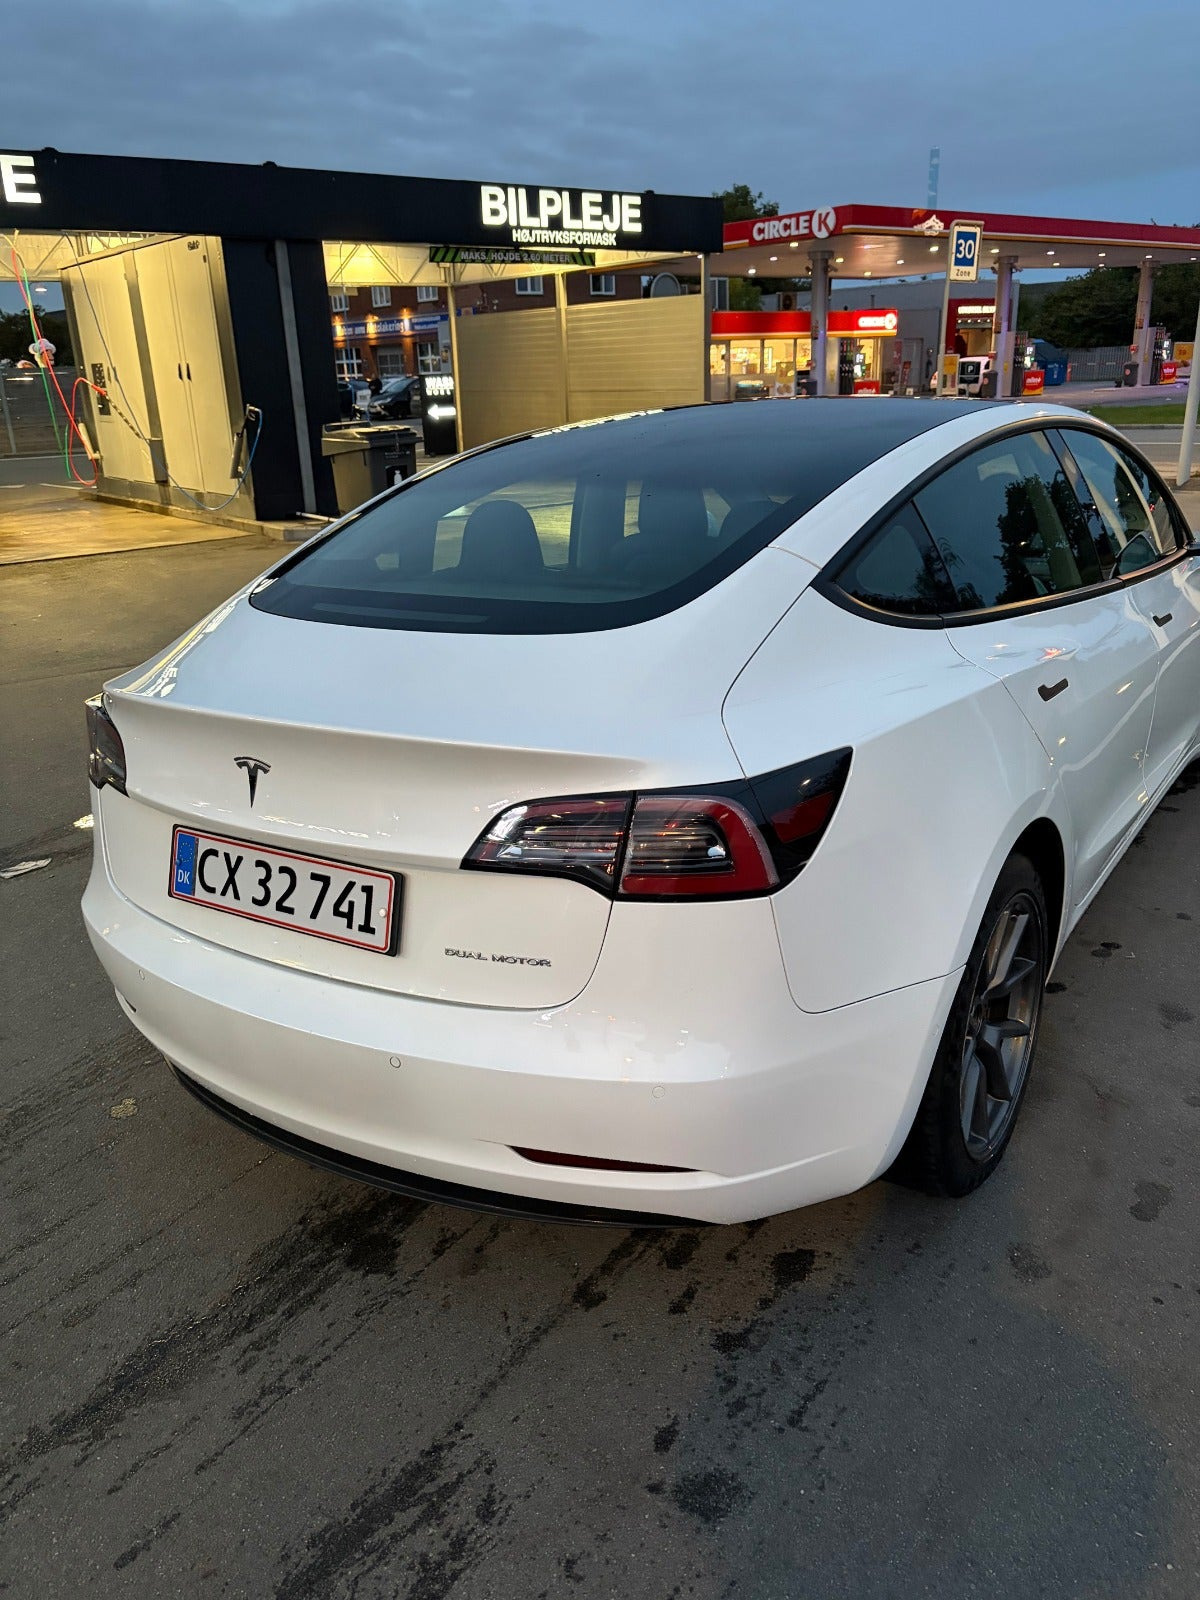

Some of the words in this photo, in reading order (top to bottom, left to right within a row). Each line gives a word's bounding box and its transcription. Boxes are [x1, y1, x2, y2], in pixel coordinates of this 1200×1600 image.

[480, 185, 642, 233] BILPLEJE
[512, 229, 616, 246] HØJTRYKSFORVASK
[753, 215, 810, 241] CIRCLE
[461, 251, 488, 261] MAKS.
[542, 254, 570, 263] METER
[956, 239, 975, 259] 30
[956, 269, 971, 277] Zone
[177, 868, 190, 885] DK
[198, 848, 243, 901] CX
[251, 860, 297, 915] 32
[309, 872, 376, 935] 741
[445, 948, 487, 960] DUAL
[492, 954, 552, 967] MOTOR
